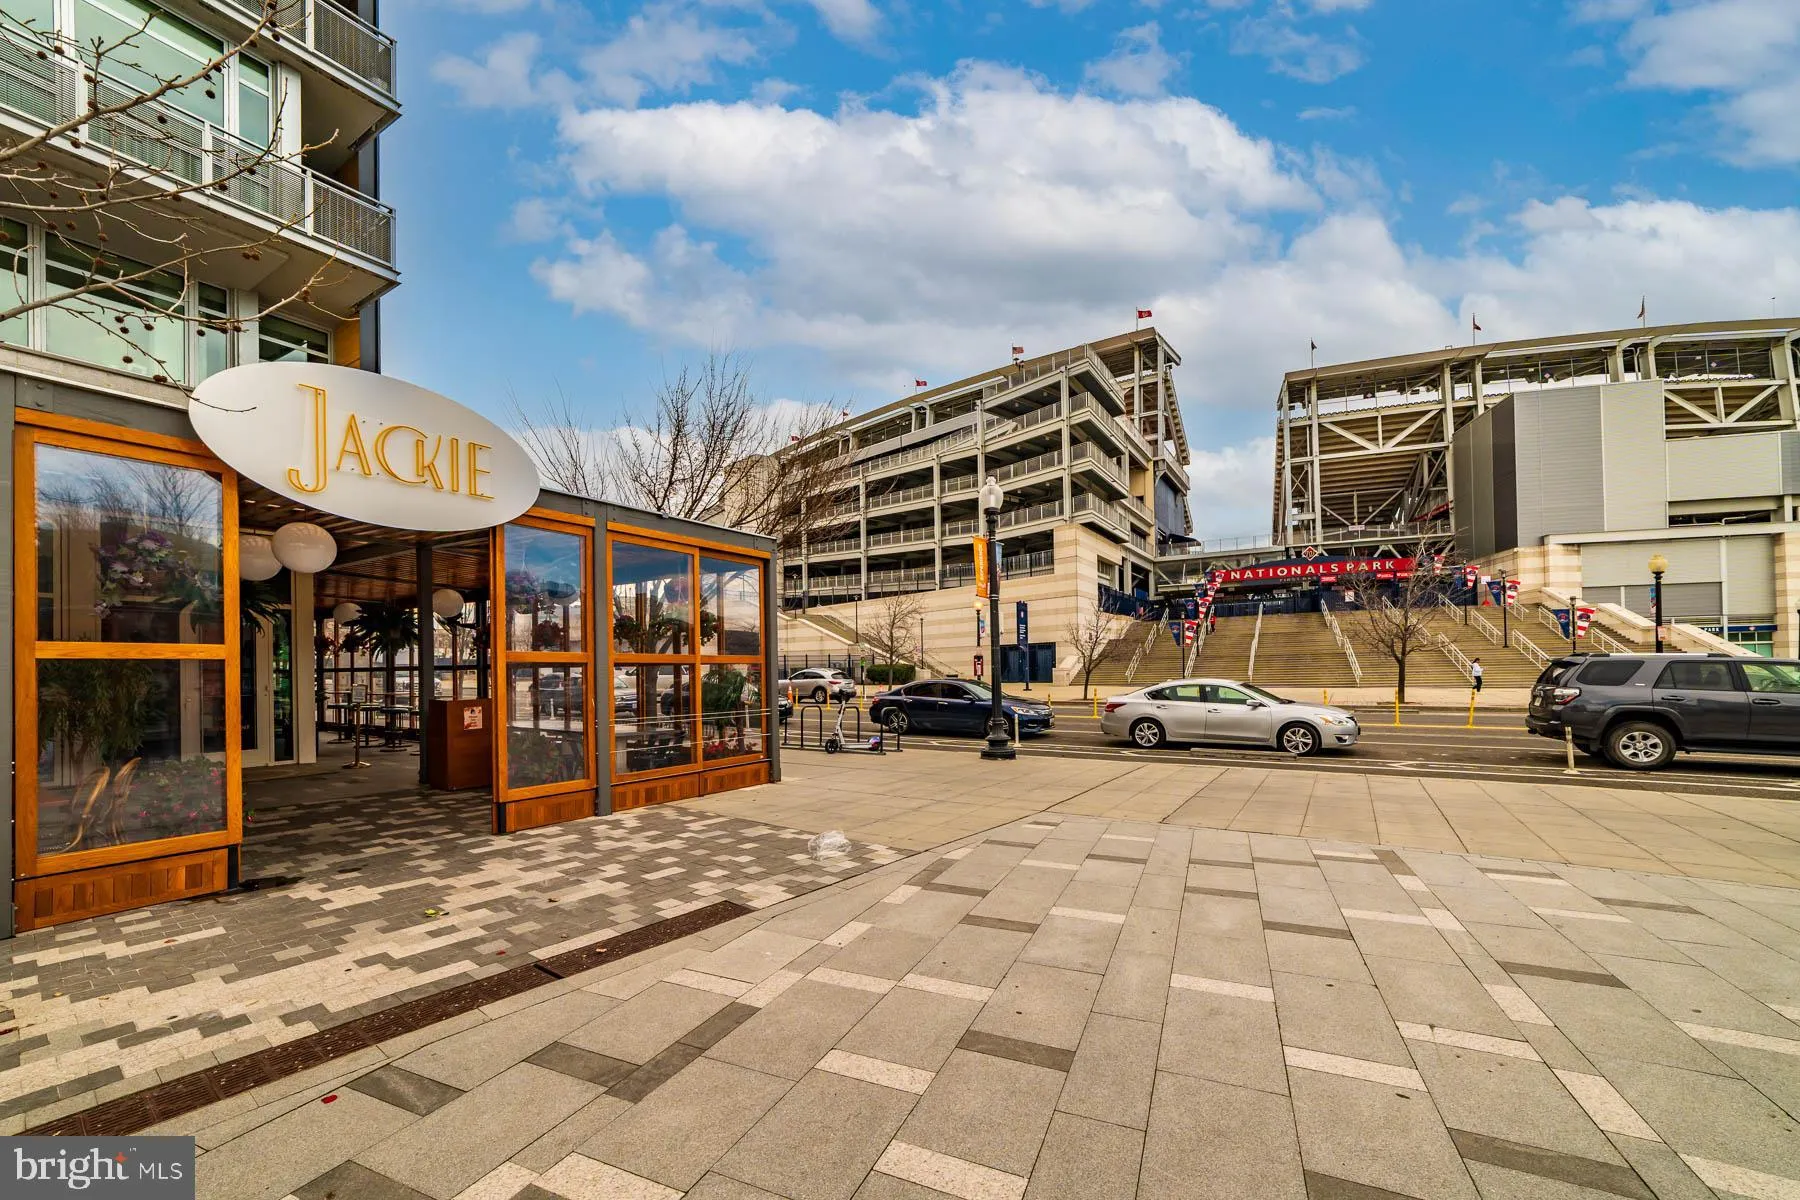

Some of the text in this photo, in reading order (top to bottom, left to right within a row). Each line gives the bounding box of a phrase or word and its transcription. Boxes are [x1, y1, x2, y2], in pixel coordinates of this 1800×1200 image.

[286, 383, 495, 501] JACKIE
[1230, 563, 1339, 580] NATIONALS
[1346, 560, 1395, 572] PARK
